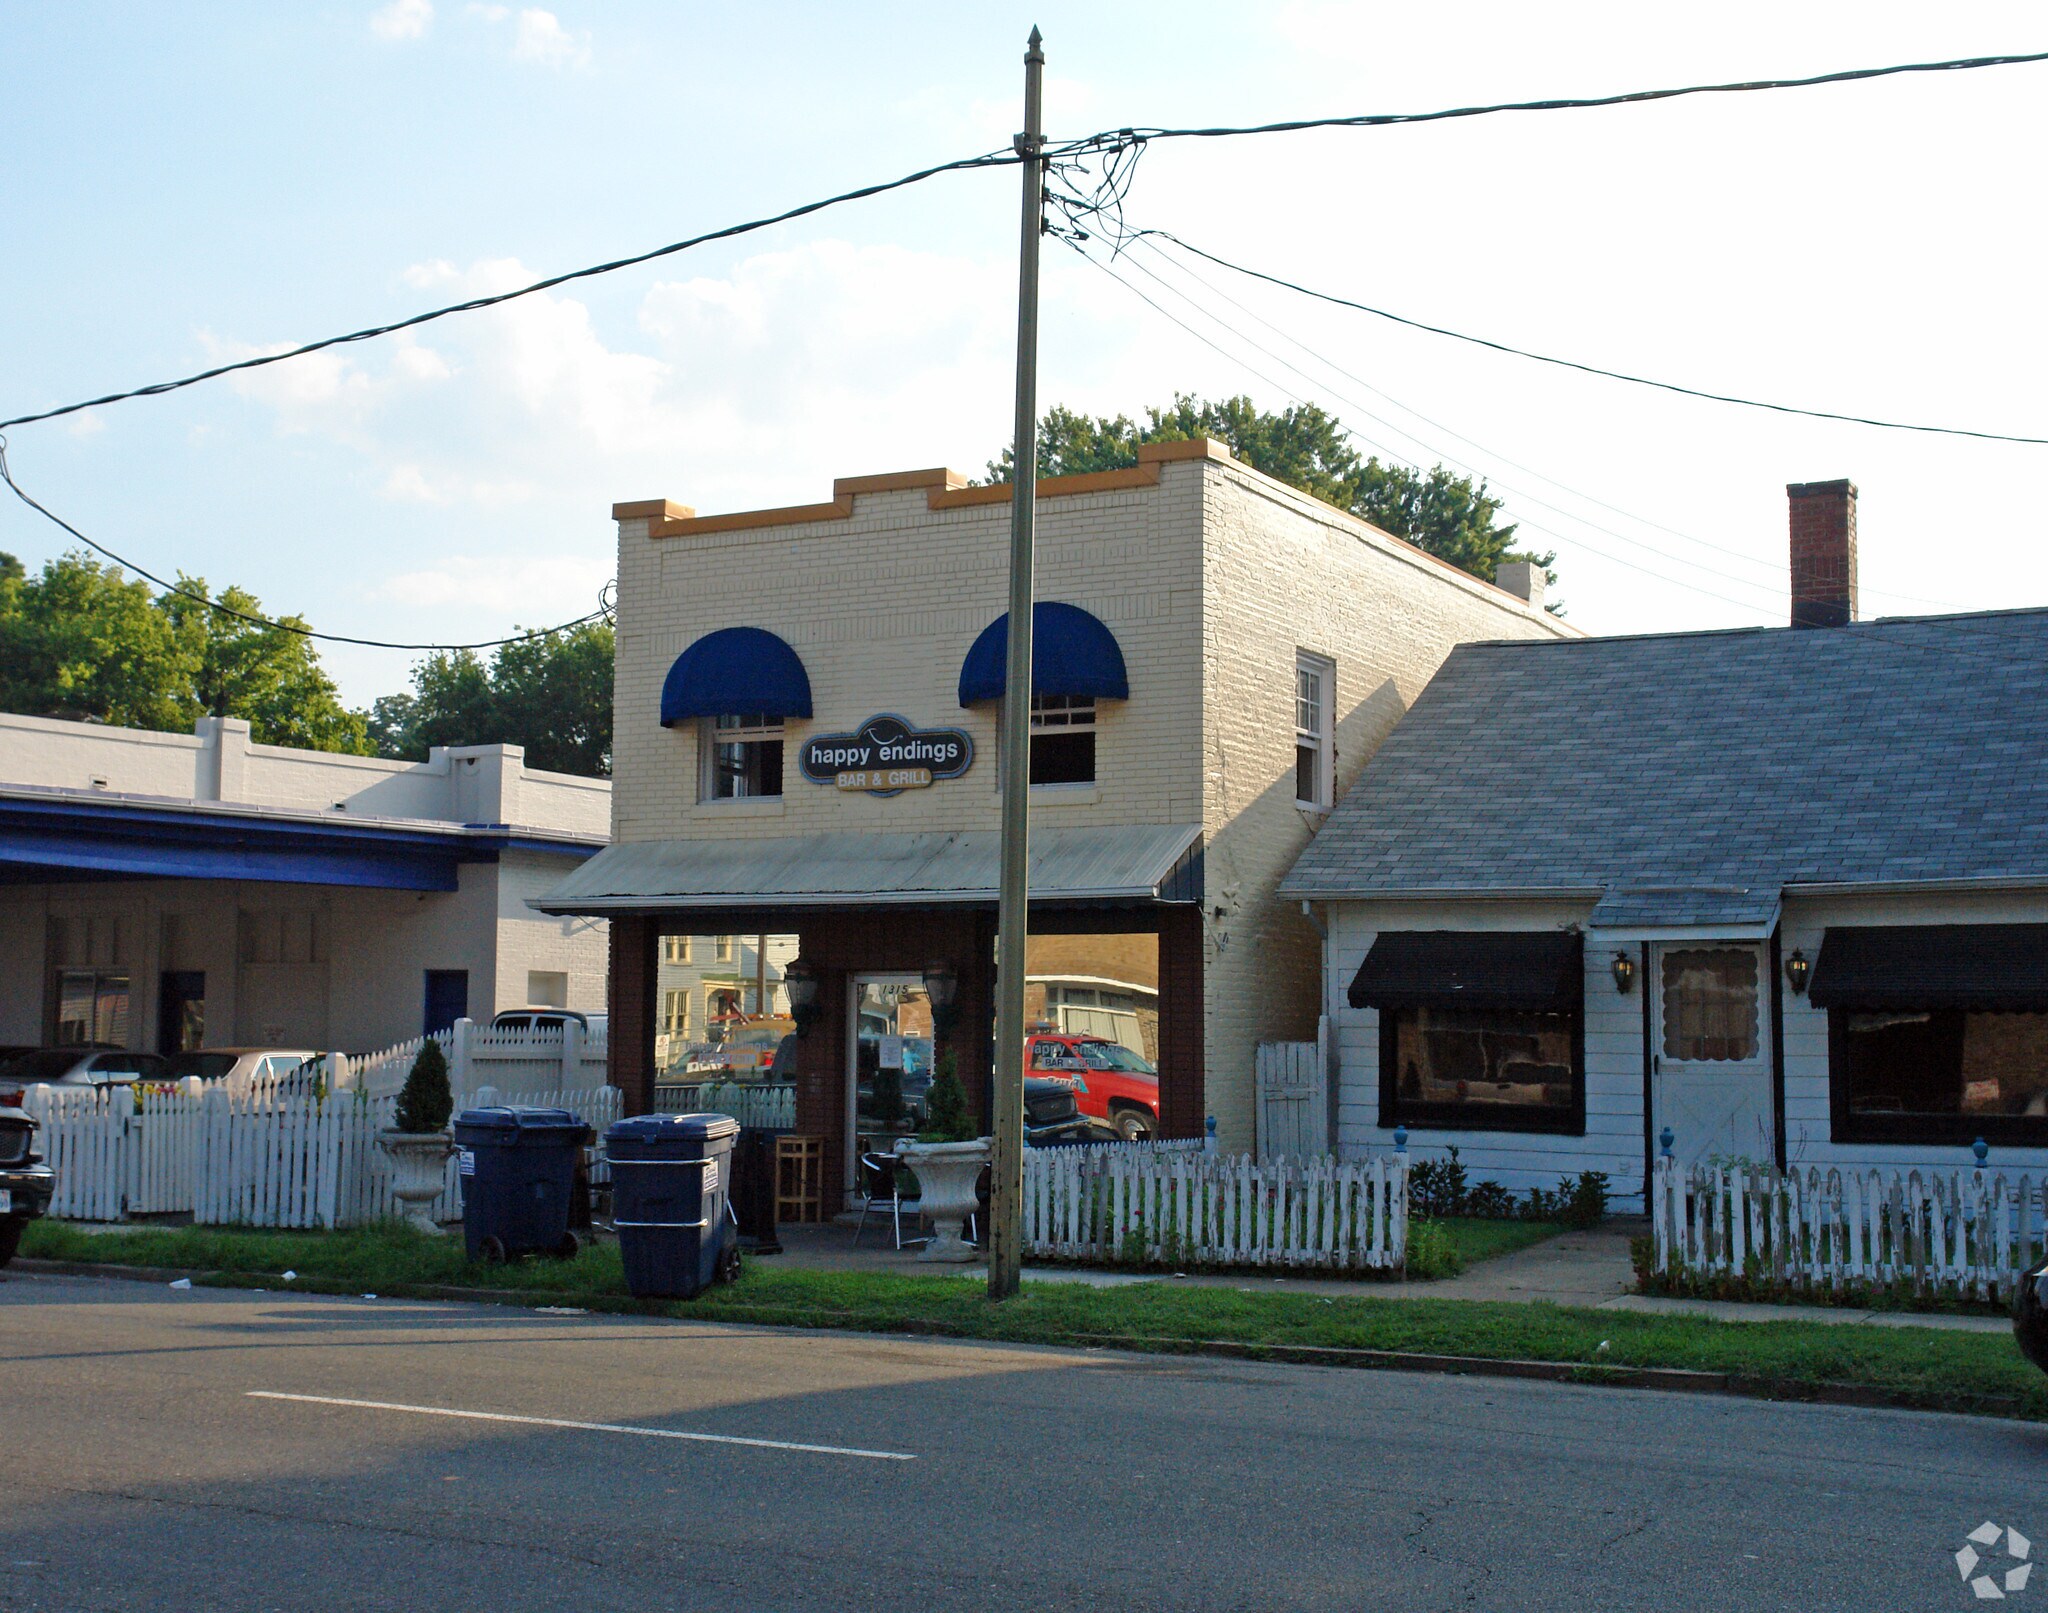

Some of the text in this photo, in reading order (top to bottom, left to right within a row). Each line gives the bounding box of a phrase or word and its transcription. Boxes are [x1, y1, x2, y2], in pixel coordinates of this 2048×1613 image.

[811, 741, 958, 766] happy endings
[838, 771, 929, 787] BAR & GRILL
[882, 984, 909, 995] 1315
[1045, 1058, 1063, 1067] BAR
